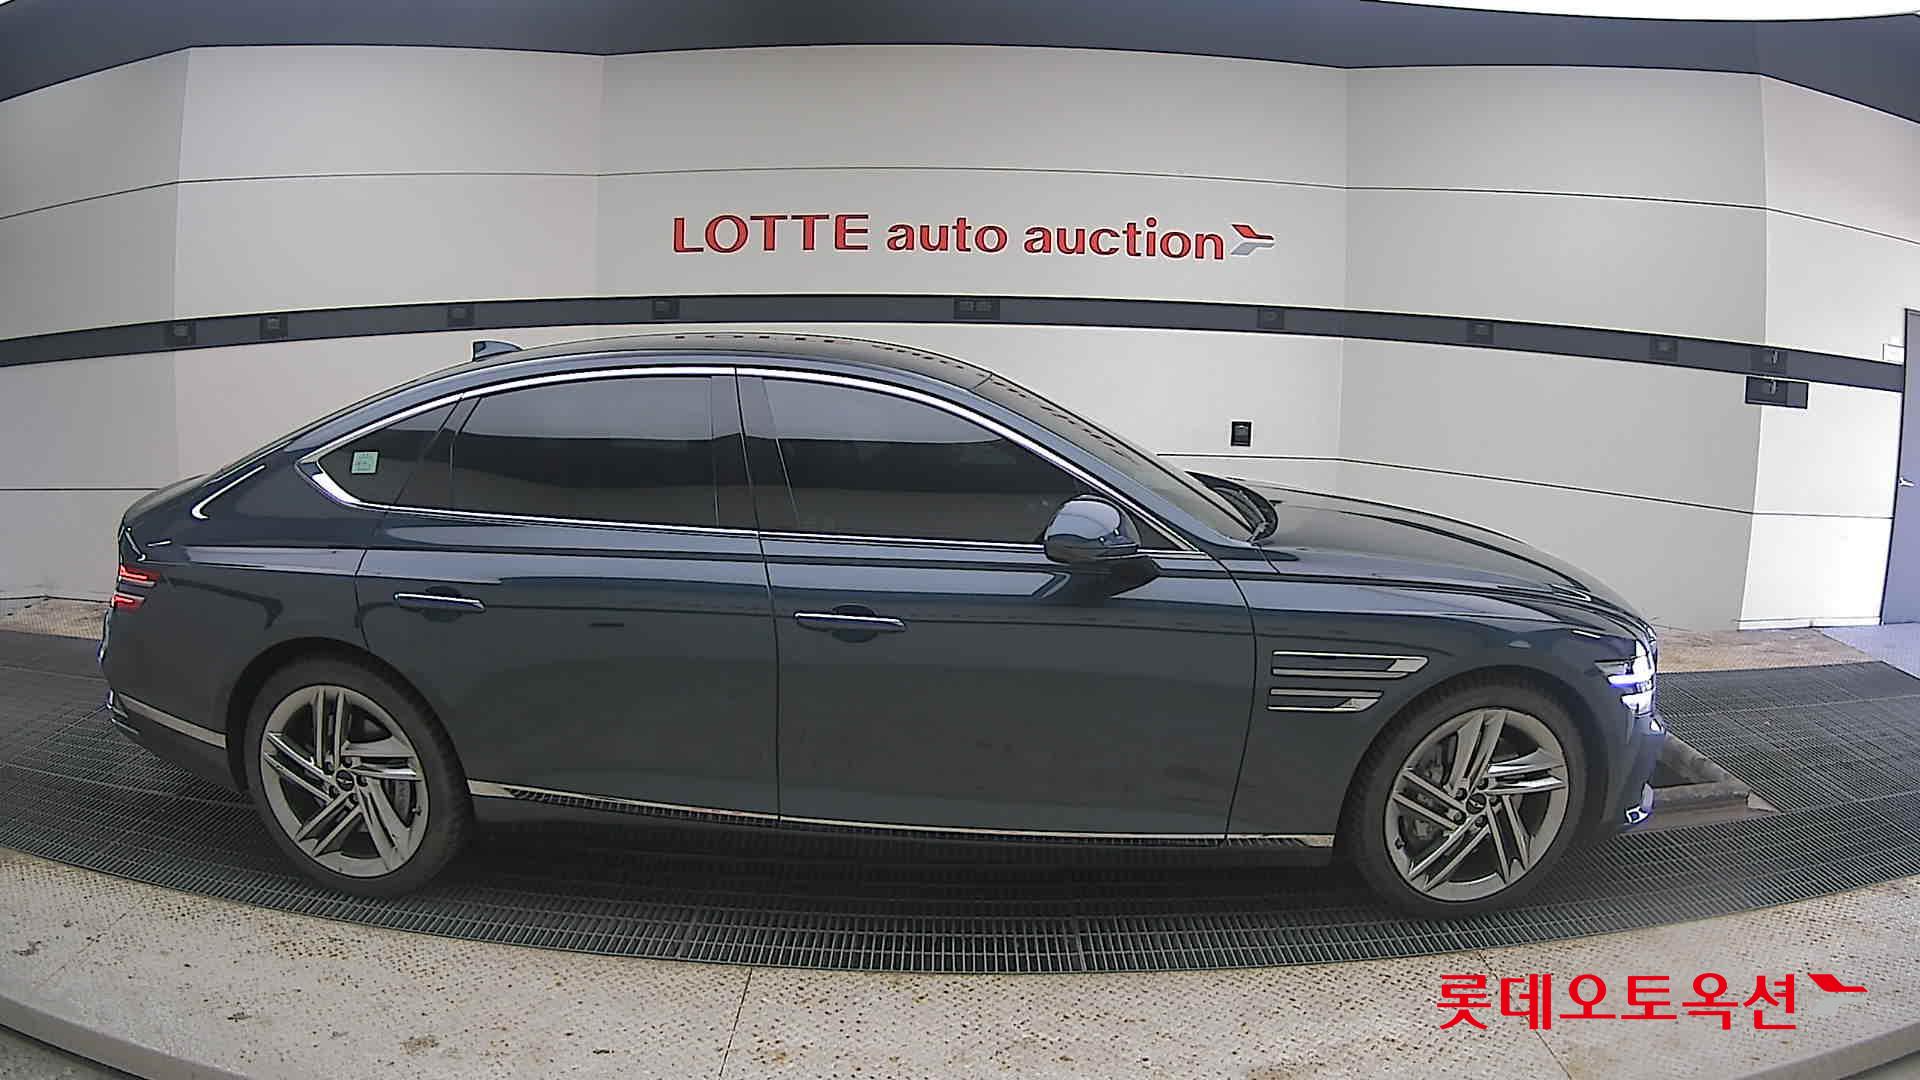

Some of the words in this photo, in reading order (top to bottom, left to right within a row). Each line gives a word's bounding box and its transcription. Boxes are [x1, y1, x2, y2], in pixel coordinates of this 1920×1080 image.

[673, 214, 869, 254] LOTTE
[886, 217, 1008, 254] auto
[1023, 216, 1225, 260] auction
